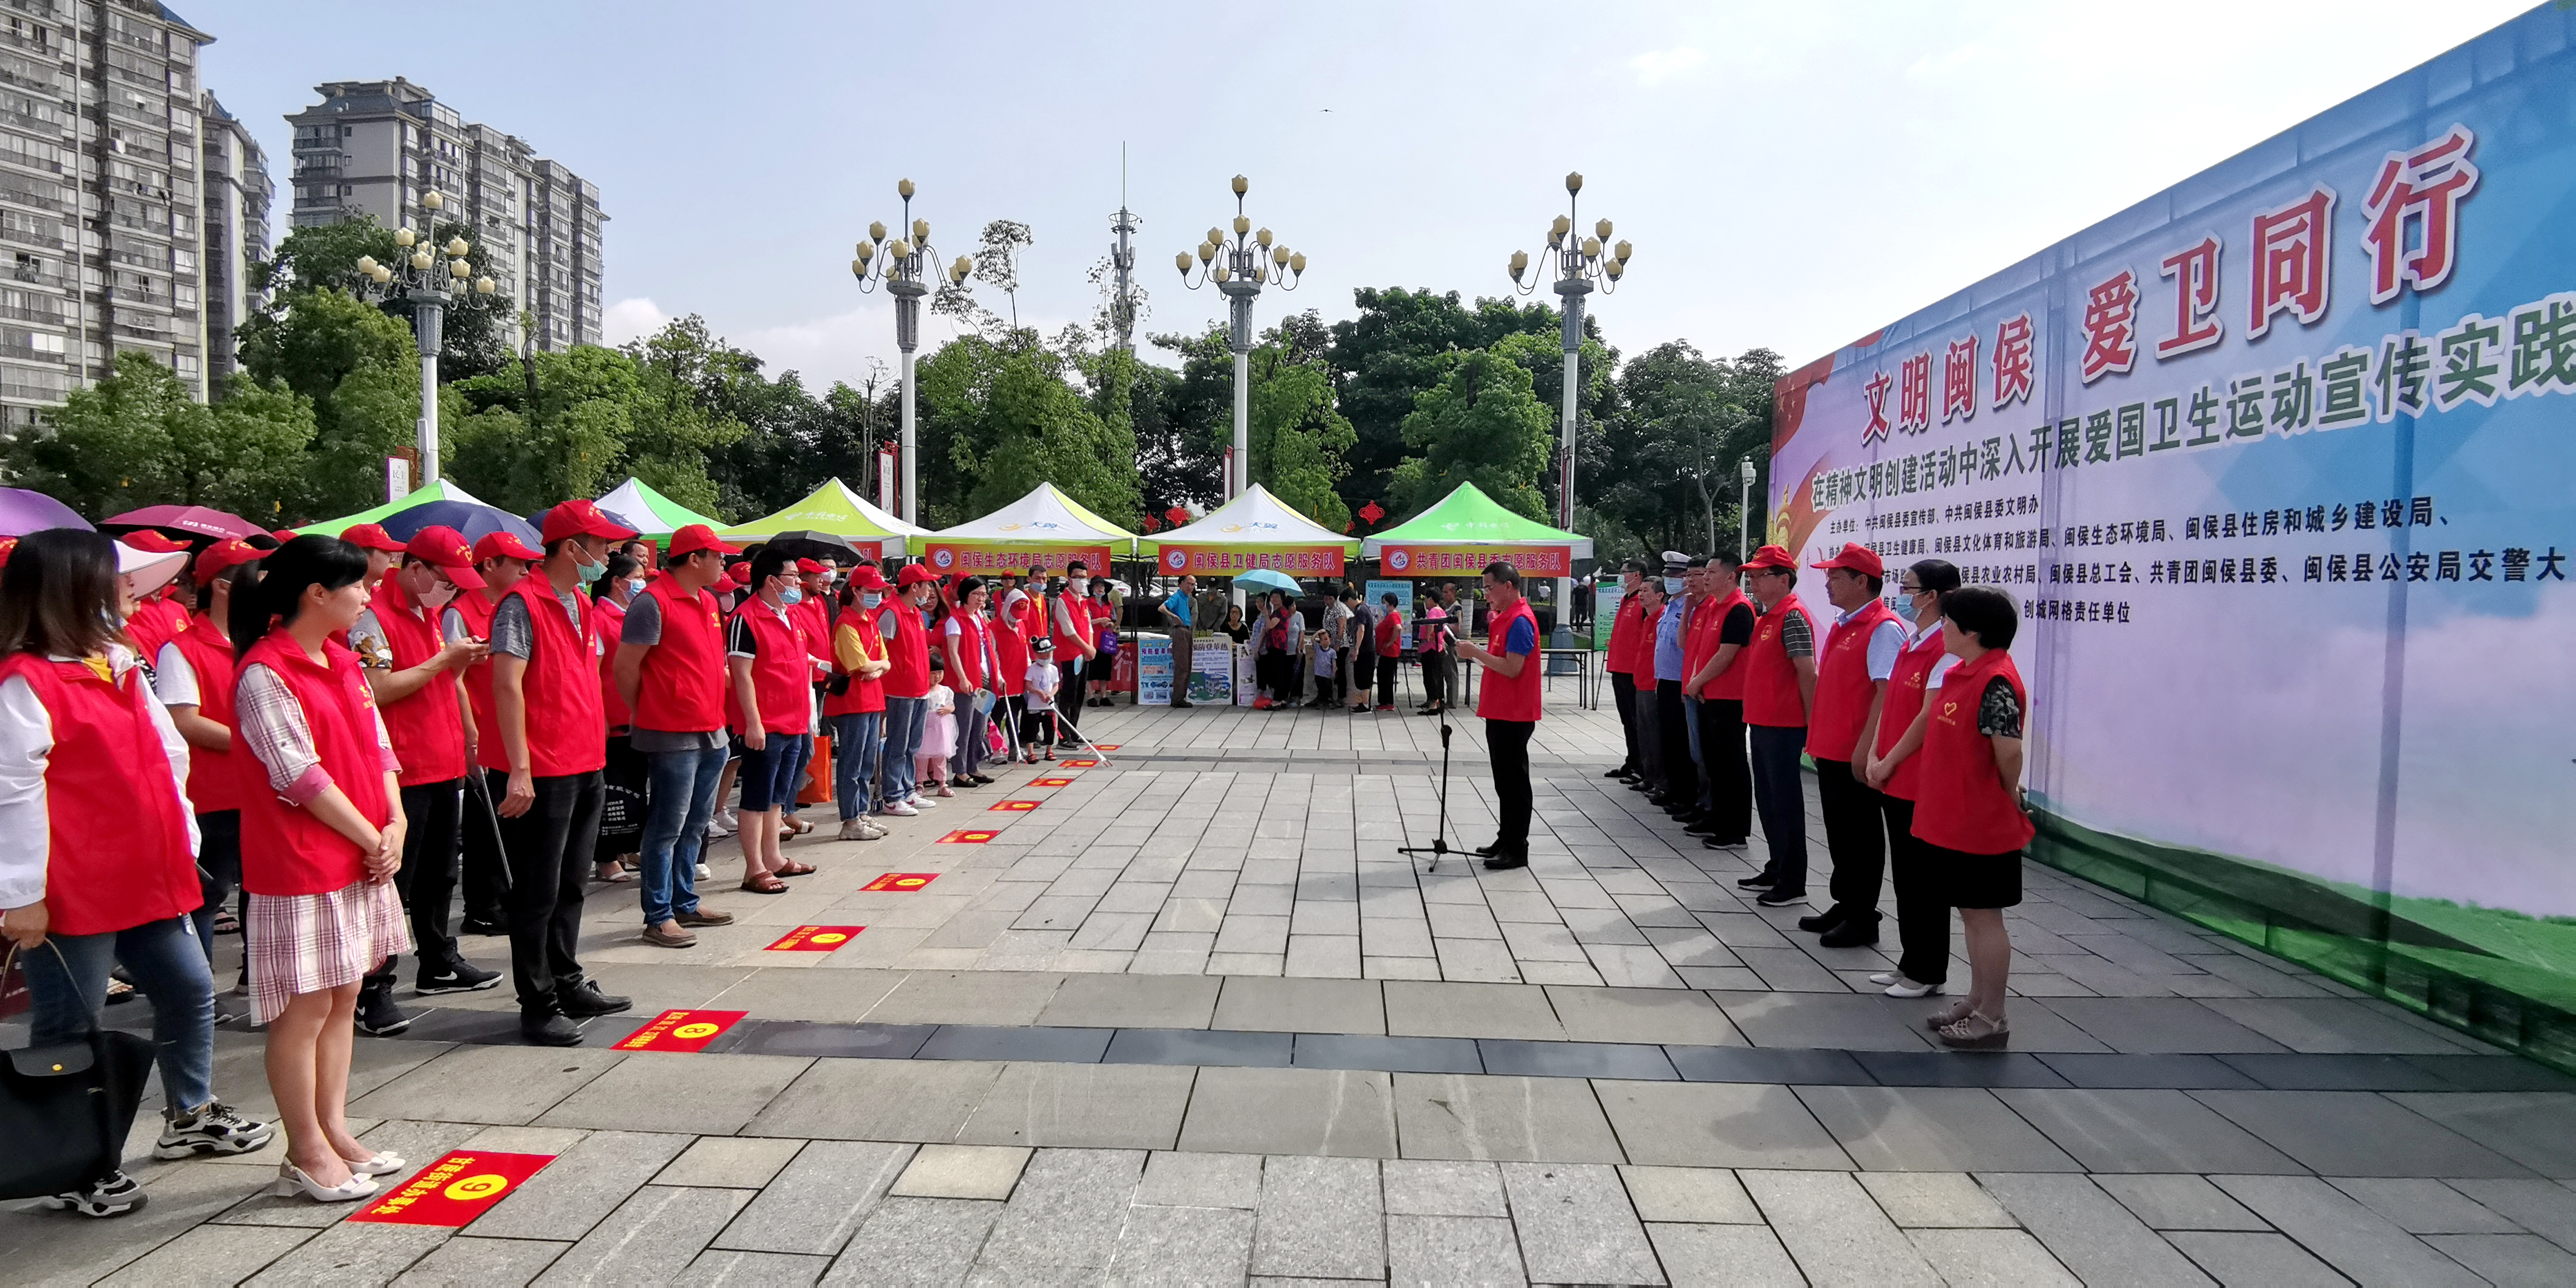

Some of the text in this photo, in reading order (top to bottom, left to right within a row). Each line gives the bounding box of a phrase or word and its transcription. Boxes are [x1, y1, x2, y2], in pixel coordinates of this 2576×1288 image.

[1862, 124, 2476, 443] 文明闽侯 爱卫同行
[1812, 300, 2576, 509] 在精神文明创建活动中深入开展爱国卫生运动宣传实践
[959, 551, 1102, 570] 闽侯生态环境局志愿服务队
[1193, 551, 1336, 570] 闽侯县卫健局志愿服务队
[1415, 552, 1562, 570] 共青团闽侯县委志愿服务队
[2024, 599, 2130, 623] 创城网格责任单位
[370, 1157, 476, 1215] 甘蔗街道办事处
[460, 1182, 493, 1192] 9
